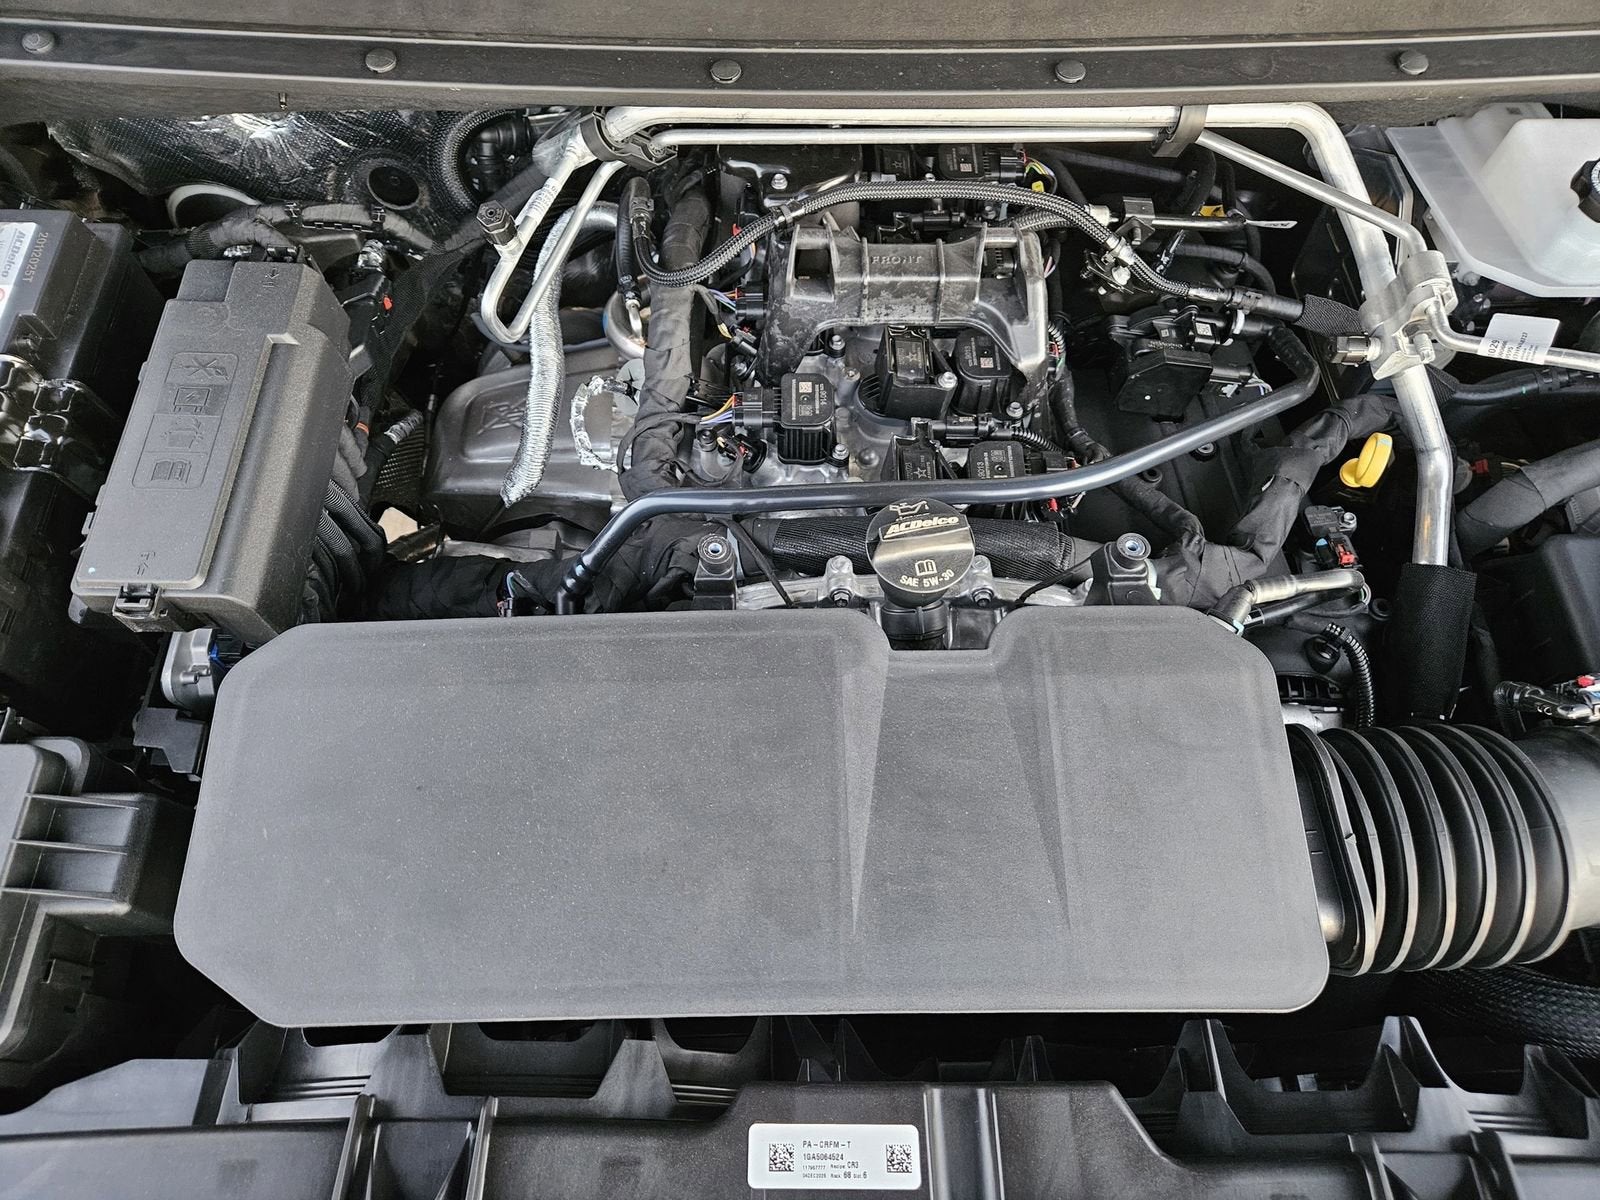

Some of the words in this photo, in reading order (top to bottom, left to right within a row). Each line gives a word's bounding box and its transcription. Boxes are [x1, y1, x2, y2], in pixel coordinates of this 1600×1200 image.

[870, 255, 922, 265] FRONT
[885, 516, 960, 536] ACDelco
[899, 575, 920, 588] SAE
[922, 569, 955, 588] 5W-30
[847, 1161, 859, 1169] CR3
[843, 1171, 852, 1179] 68
[862, 1171, 868, 1179] 6
